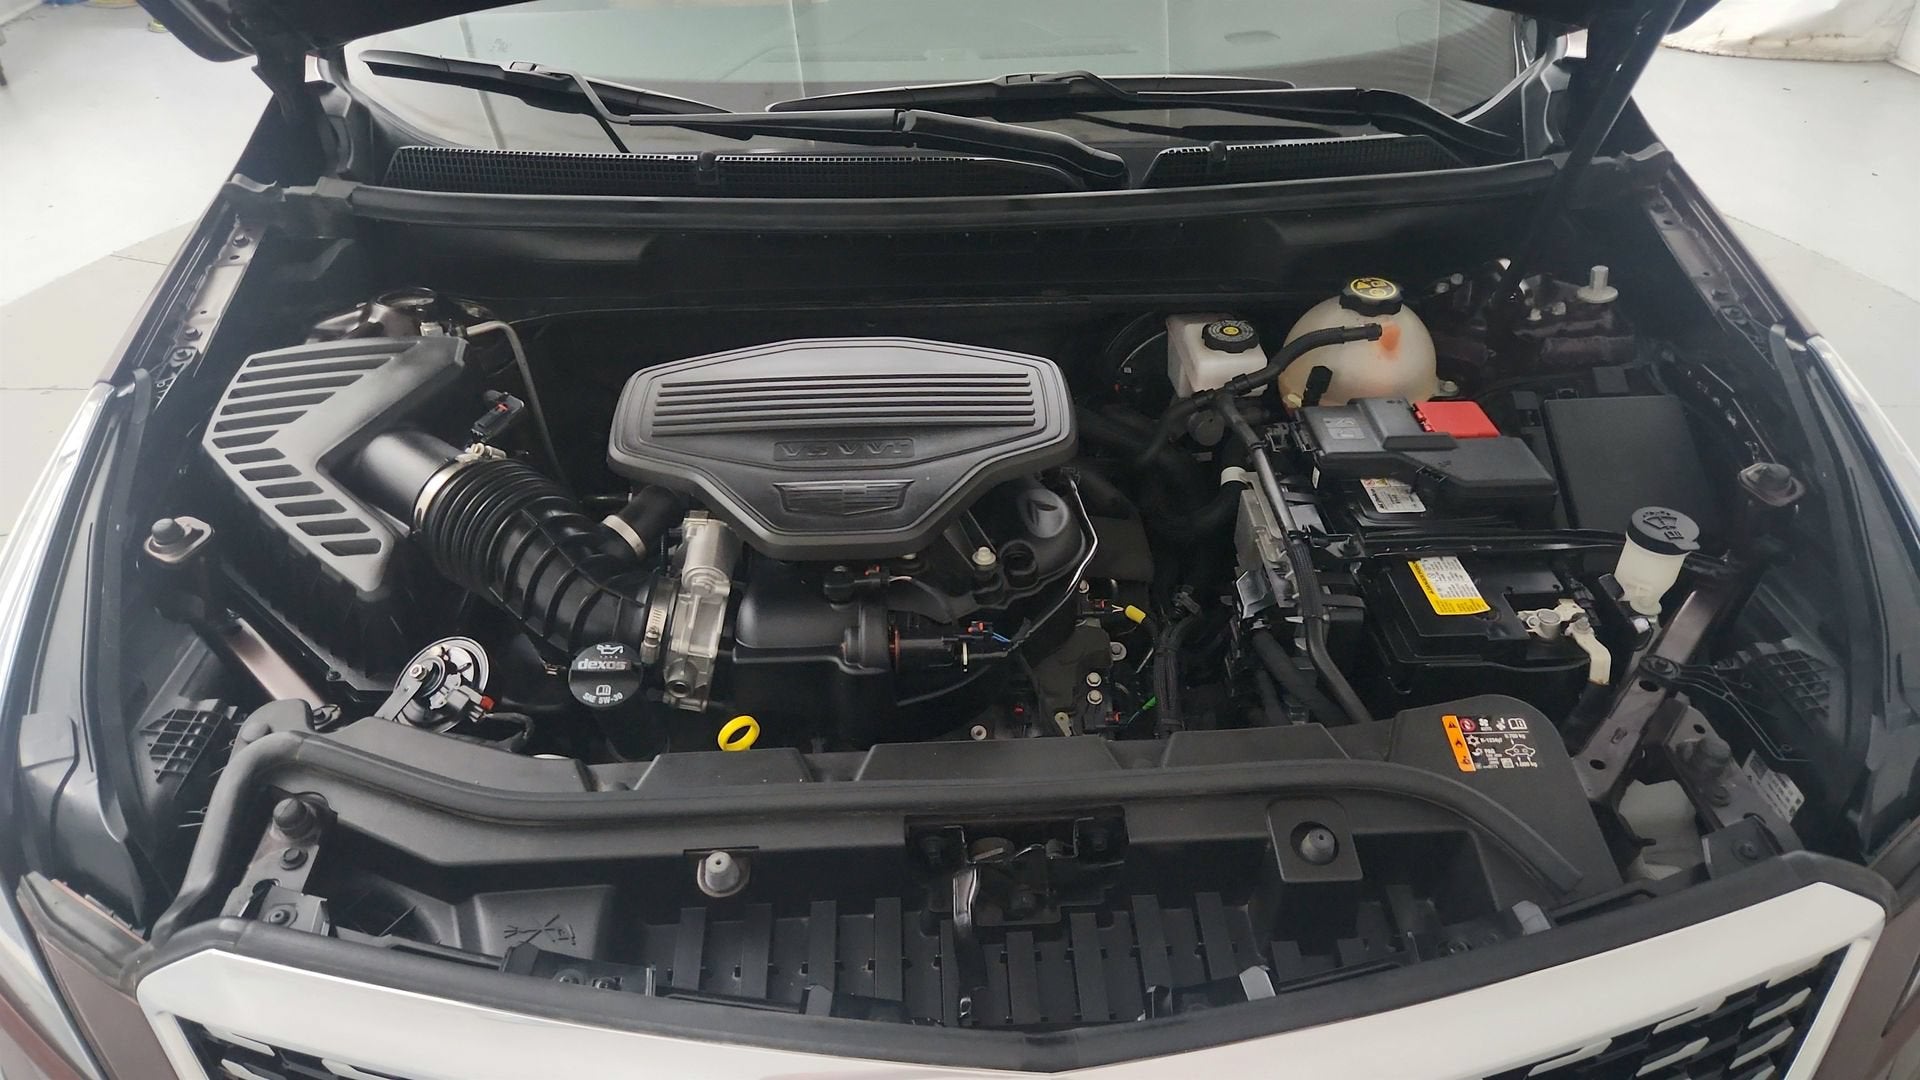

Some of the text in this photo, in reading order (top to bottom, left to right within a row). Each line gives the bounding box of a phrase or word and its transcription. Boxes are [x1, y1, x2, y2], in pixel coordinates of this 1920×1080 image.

[577, 658, 627, 670] dexos
[583, 692, 623, 704] SAE 5W-30
